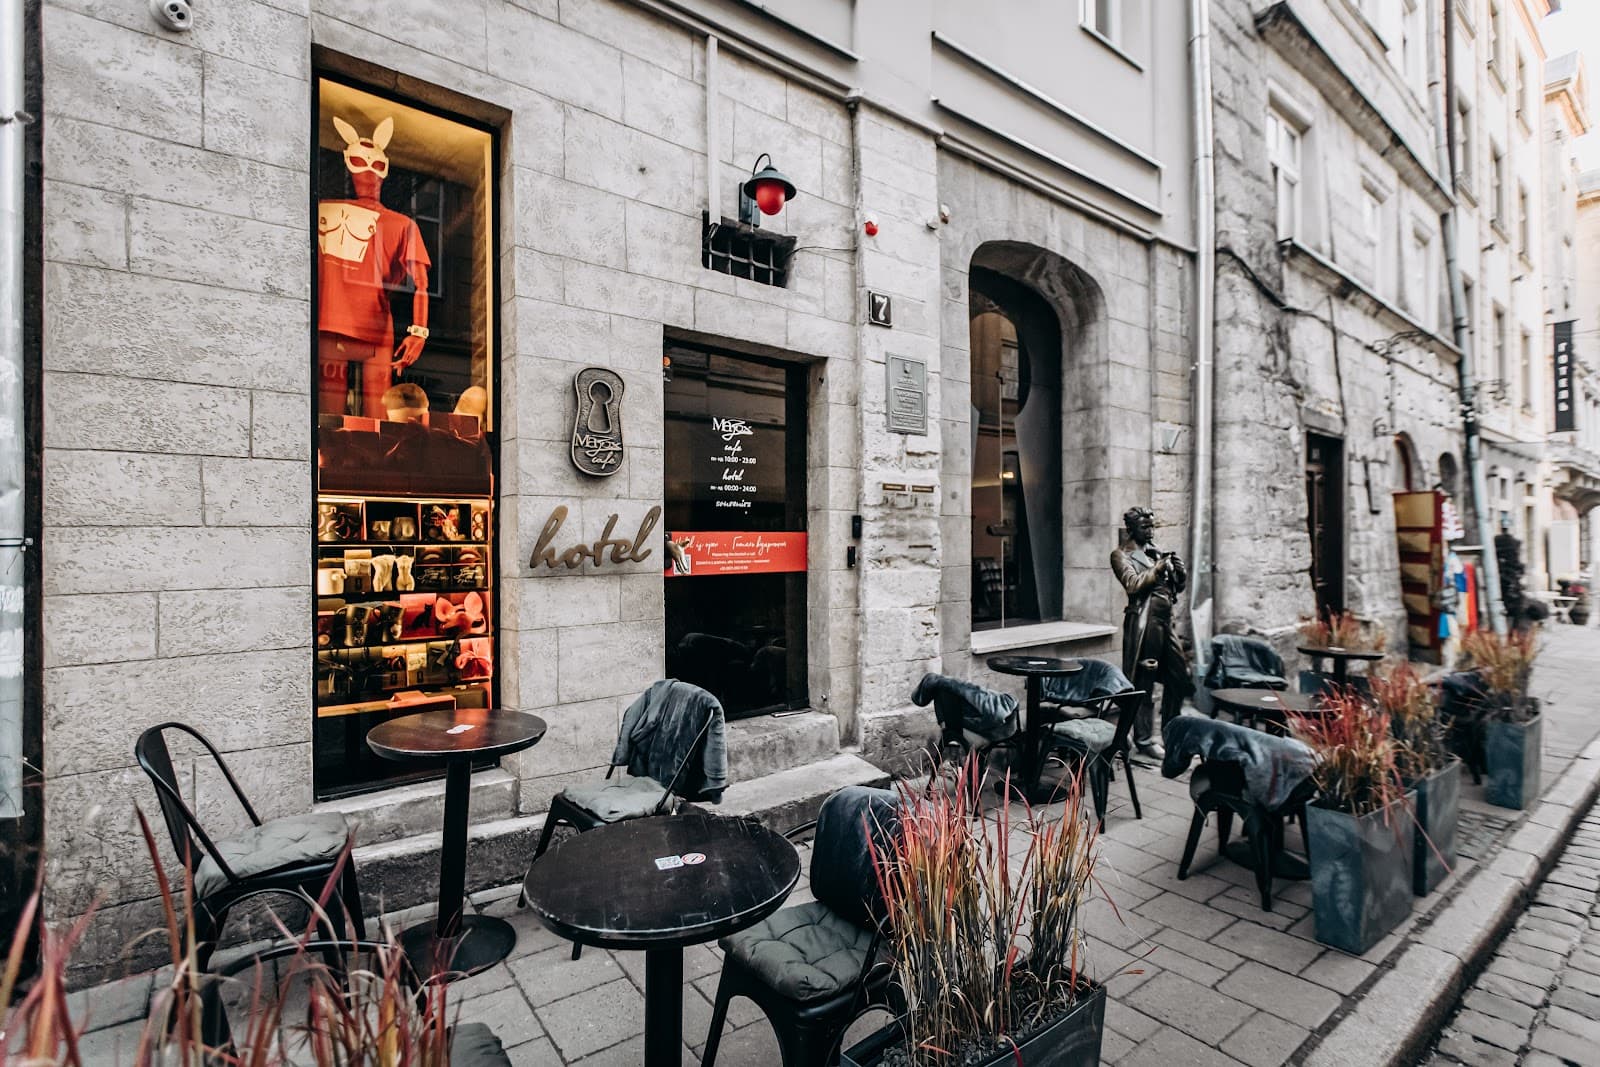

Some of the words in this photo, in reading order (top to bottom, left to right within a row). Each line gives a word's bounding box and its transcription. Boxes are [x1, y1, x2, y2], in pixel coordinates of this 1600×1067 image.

[875, 295, 887, 320] 7
[724, 440, 742, 456] cafe
[591, 451, 616, 469] cafe
[725, 455, 738, 463] 10:00
[722, 467, 745, 480] hotel
[529, 504, 662, 570] hotel
